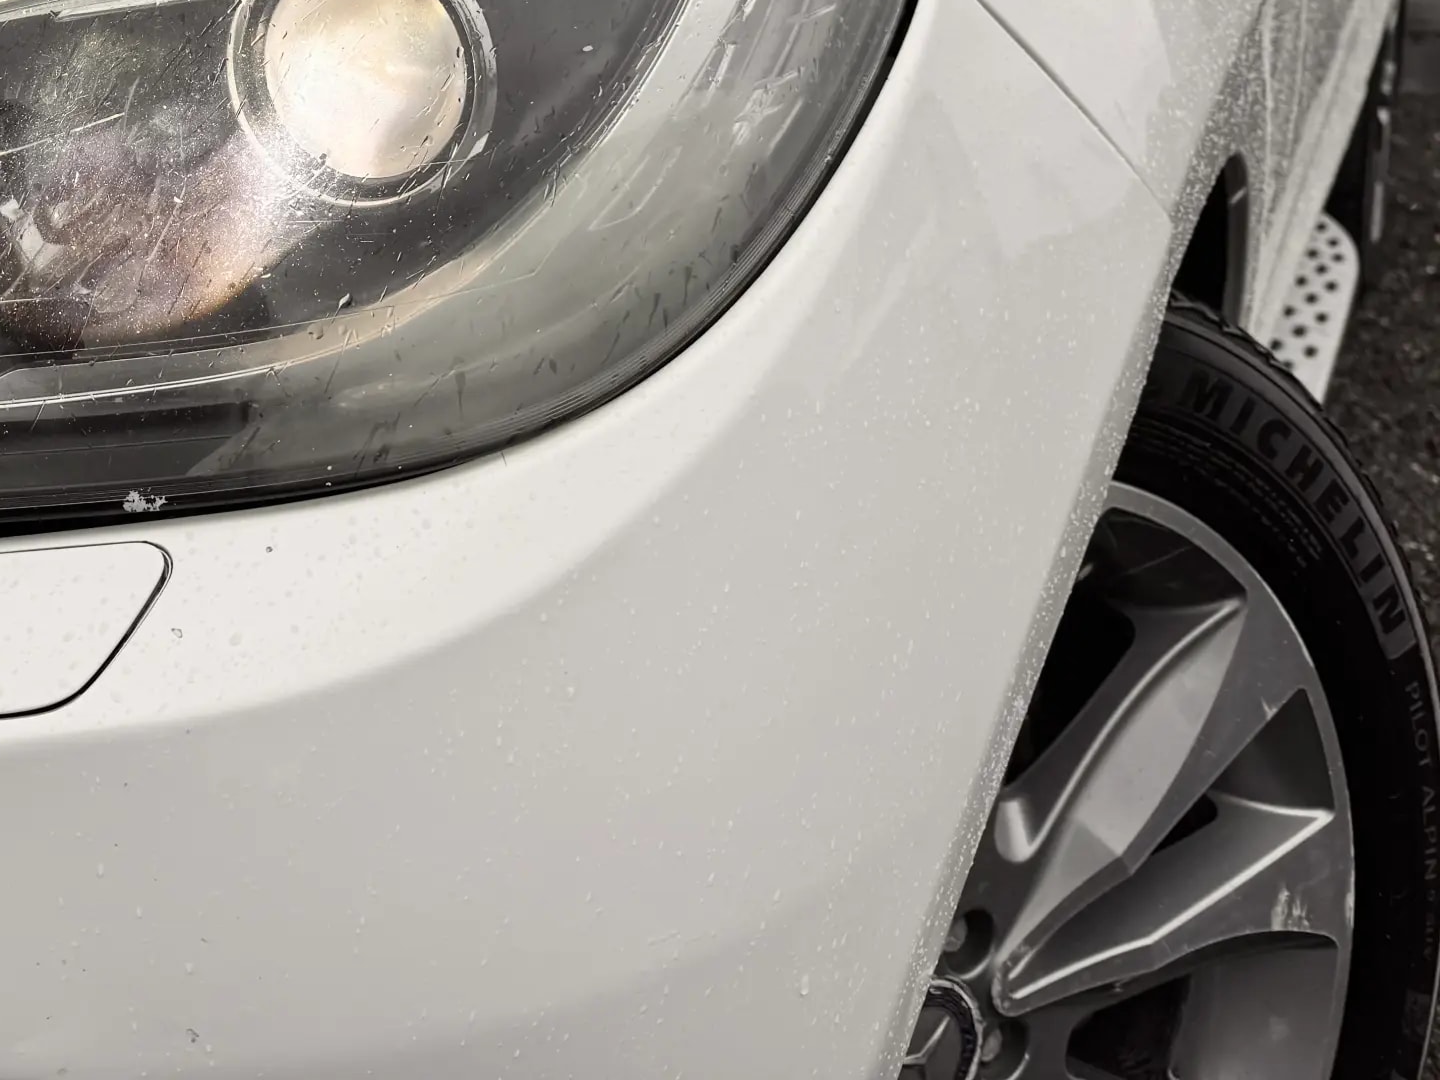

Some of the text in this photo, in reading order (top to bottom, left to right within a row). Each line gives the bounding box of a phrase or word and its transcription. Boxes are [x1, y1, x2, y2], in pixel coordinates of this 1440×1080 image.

[1178, 370, 1406, 635] MICHELIN
[1404, 681, 1432, 767] PILOT
[1421, 785, 1438, 880] ALPIN
